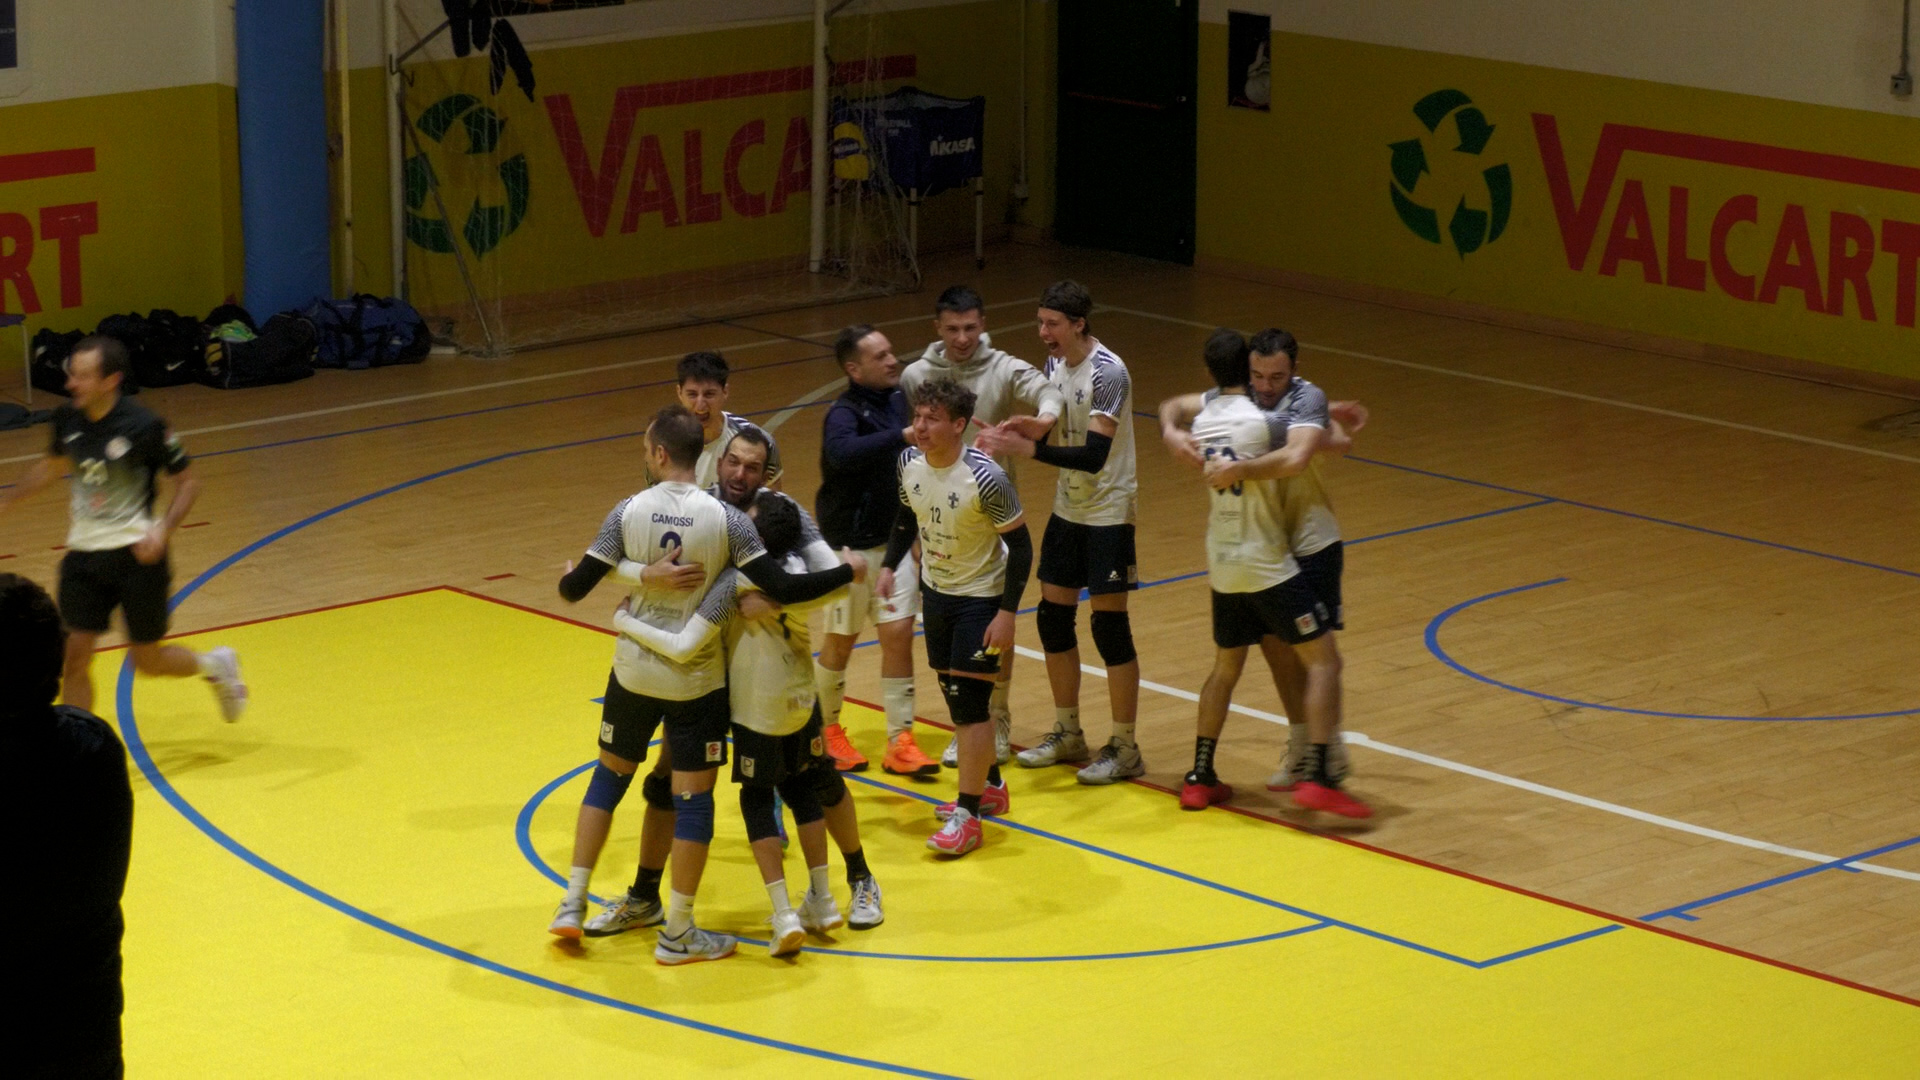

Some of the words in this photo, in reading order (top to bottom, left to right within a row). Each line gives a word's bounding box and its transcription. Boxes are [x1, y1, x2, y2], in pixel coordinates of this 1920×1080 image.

[544, 54, 916, 237] VALCA
[1531, 113, 1920, 328] VALCART
[651, 513, 694, 527] CAMOSSI
[930, 506, 941, 524] 12
